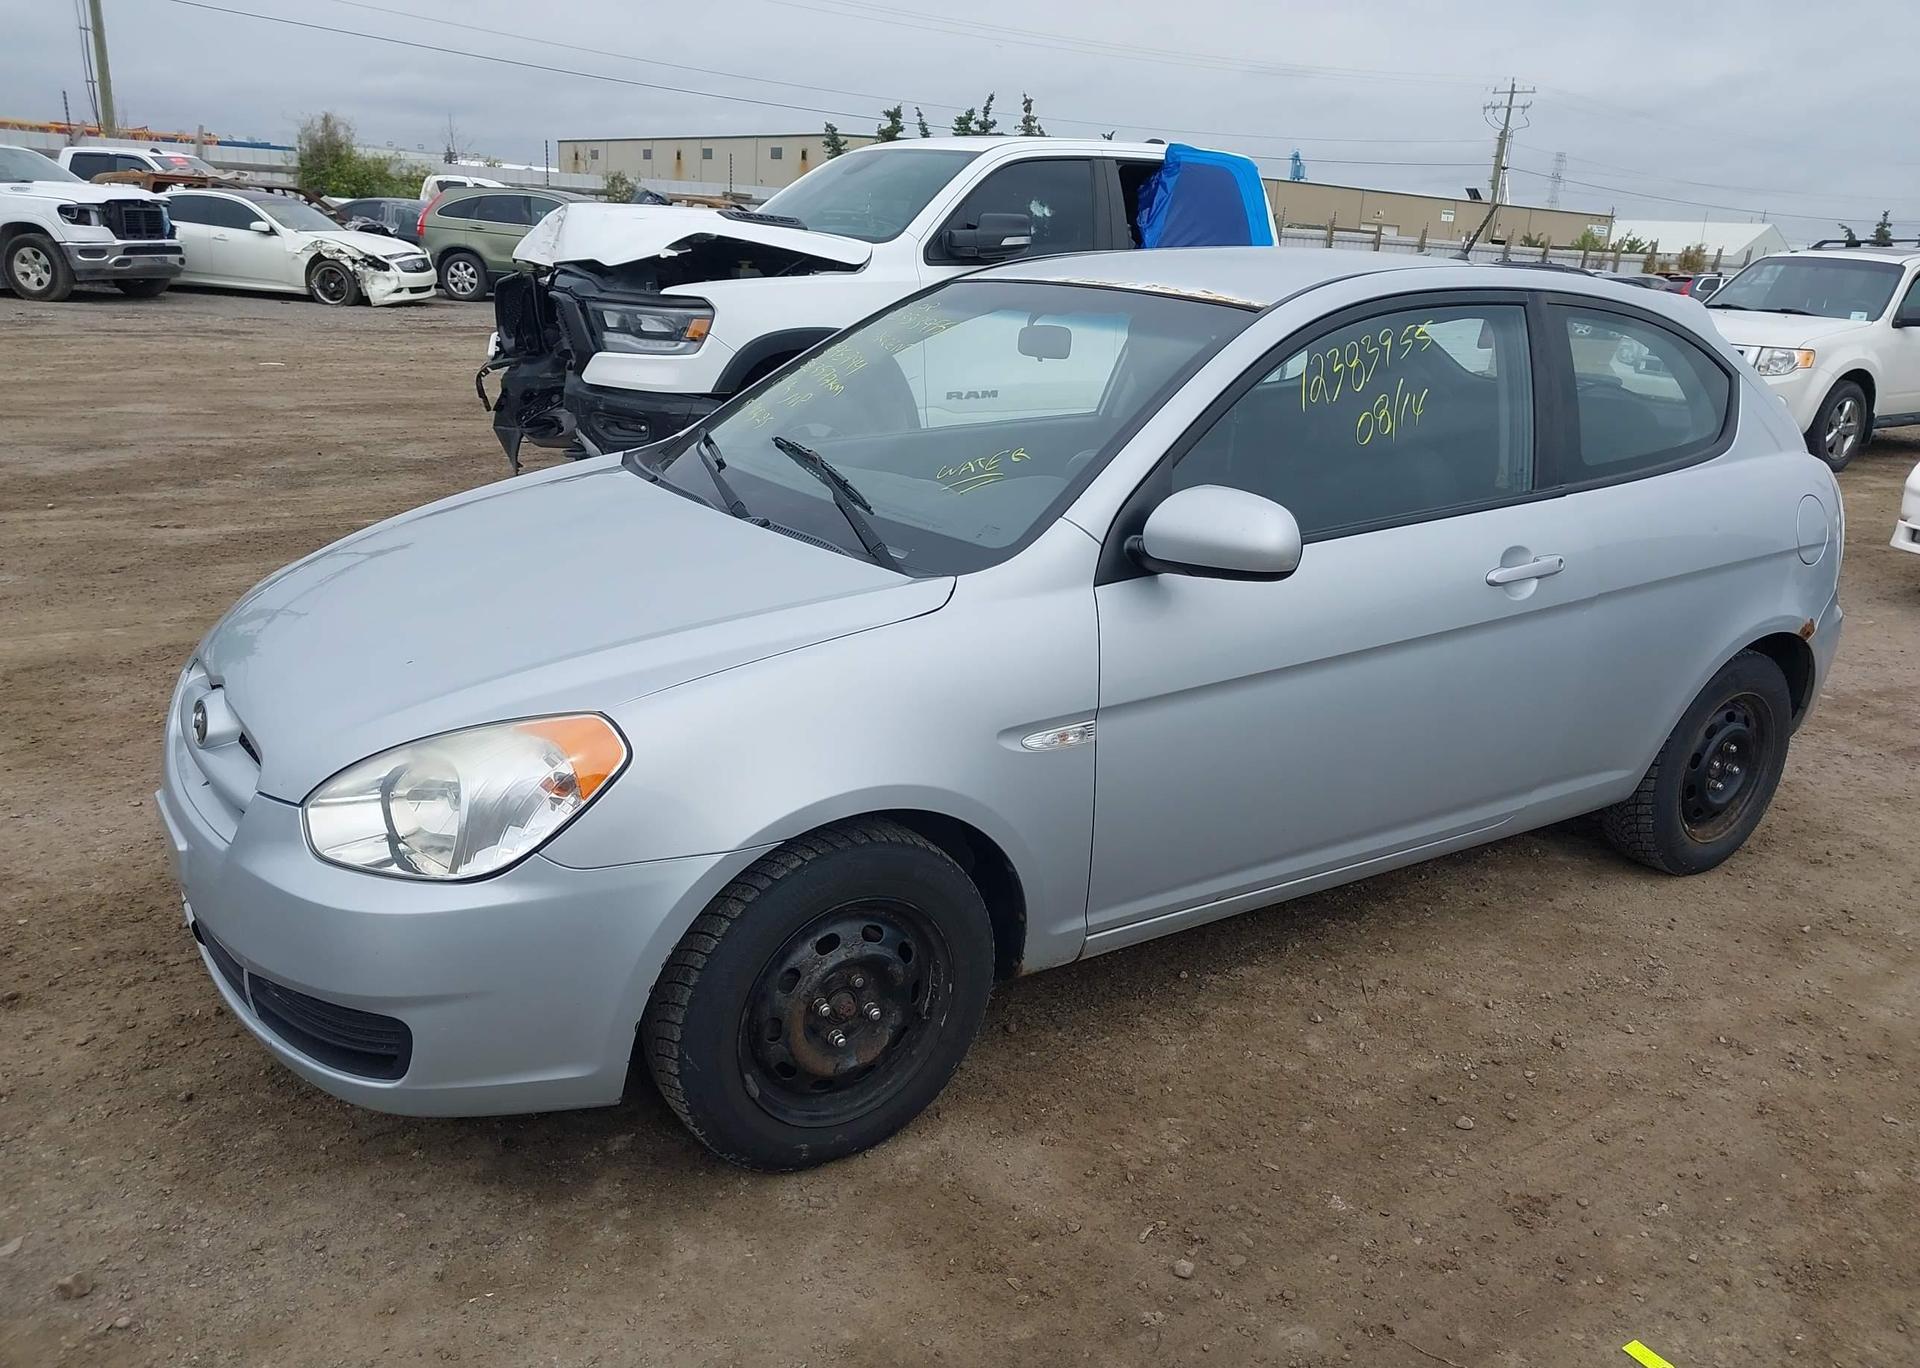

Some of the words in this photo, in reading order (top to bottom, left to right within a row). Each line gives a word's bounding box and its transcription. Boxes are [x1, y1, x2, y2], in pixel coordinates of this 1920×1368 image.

[1301, 319, 1434, 413] 12383955
[945, 389, 999, 401] RAM
[1356, 377, 1429, 445] 08/14
[936, 447, 1032, 479] WATER
